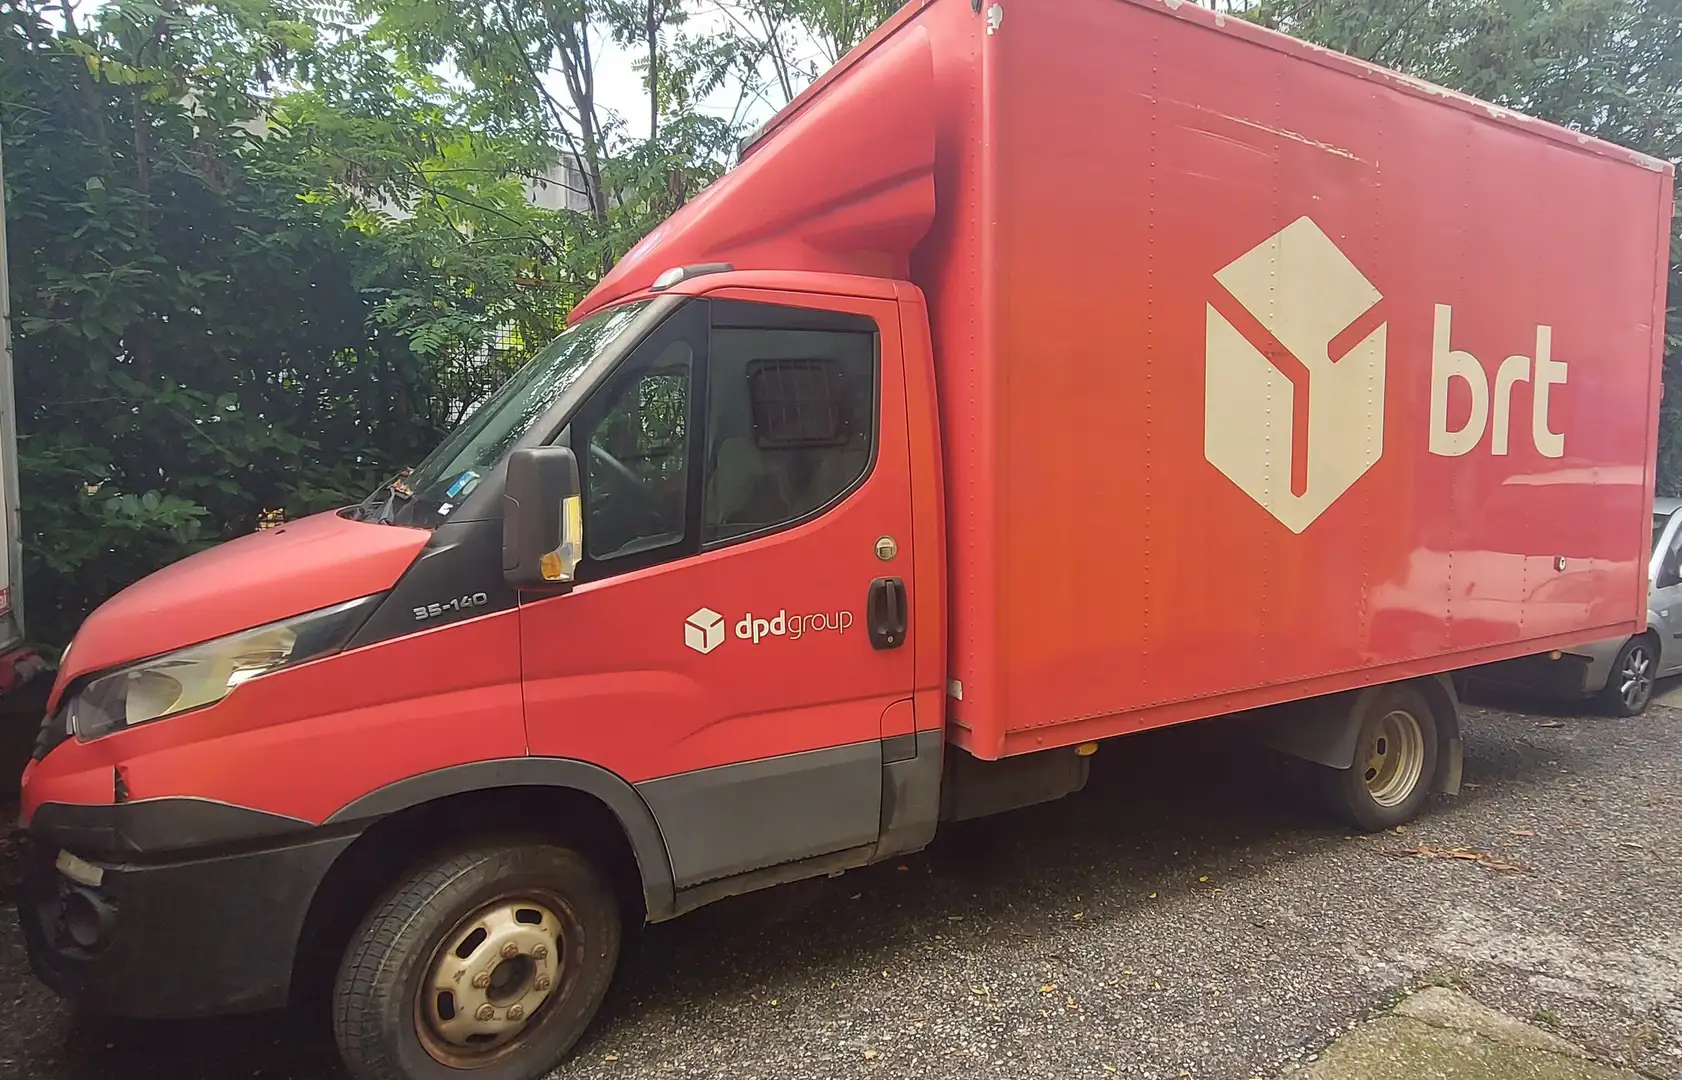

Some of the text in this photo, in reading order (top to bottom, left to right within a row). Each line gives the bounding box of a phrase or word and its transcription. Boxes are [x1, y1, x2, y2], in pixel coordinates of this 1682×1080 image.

[1428, 303, 1568, 458] brt
[413, 592, 488, 620] 35-140
[735, 609, 853, 644] dpdgroup
